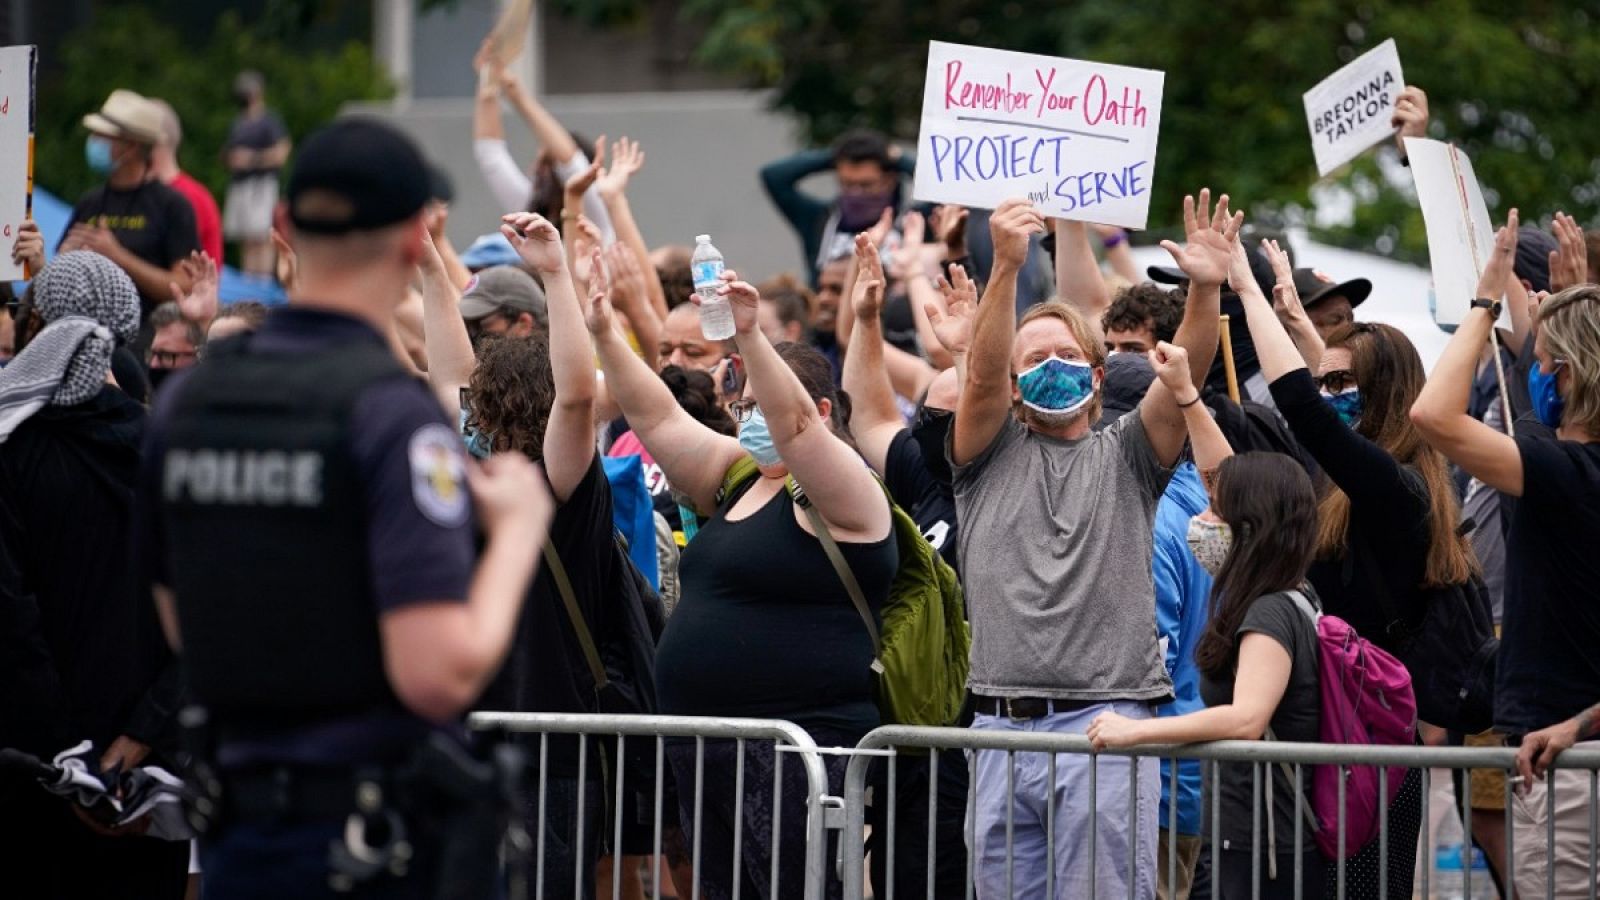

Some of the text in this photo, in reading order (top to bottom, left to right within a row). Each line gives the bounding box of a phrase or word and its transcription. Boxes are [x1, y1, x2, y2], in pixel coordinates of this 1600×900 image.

[945, 60, 1147, 128] Remember Your Oath
[1314, 70, 1395, 134] BREONNA
[1326, 92, 1390, 144] TAYLOR
[931, 135, 1070, 182] PROTECT
[1027, 160, 1148, 212] and SERVE
[164, 450, 322, 505] POLICE
